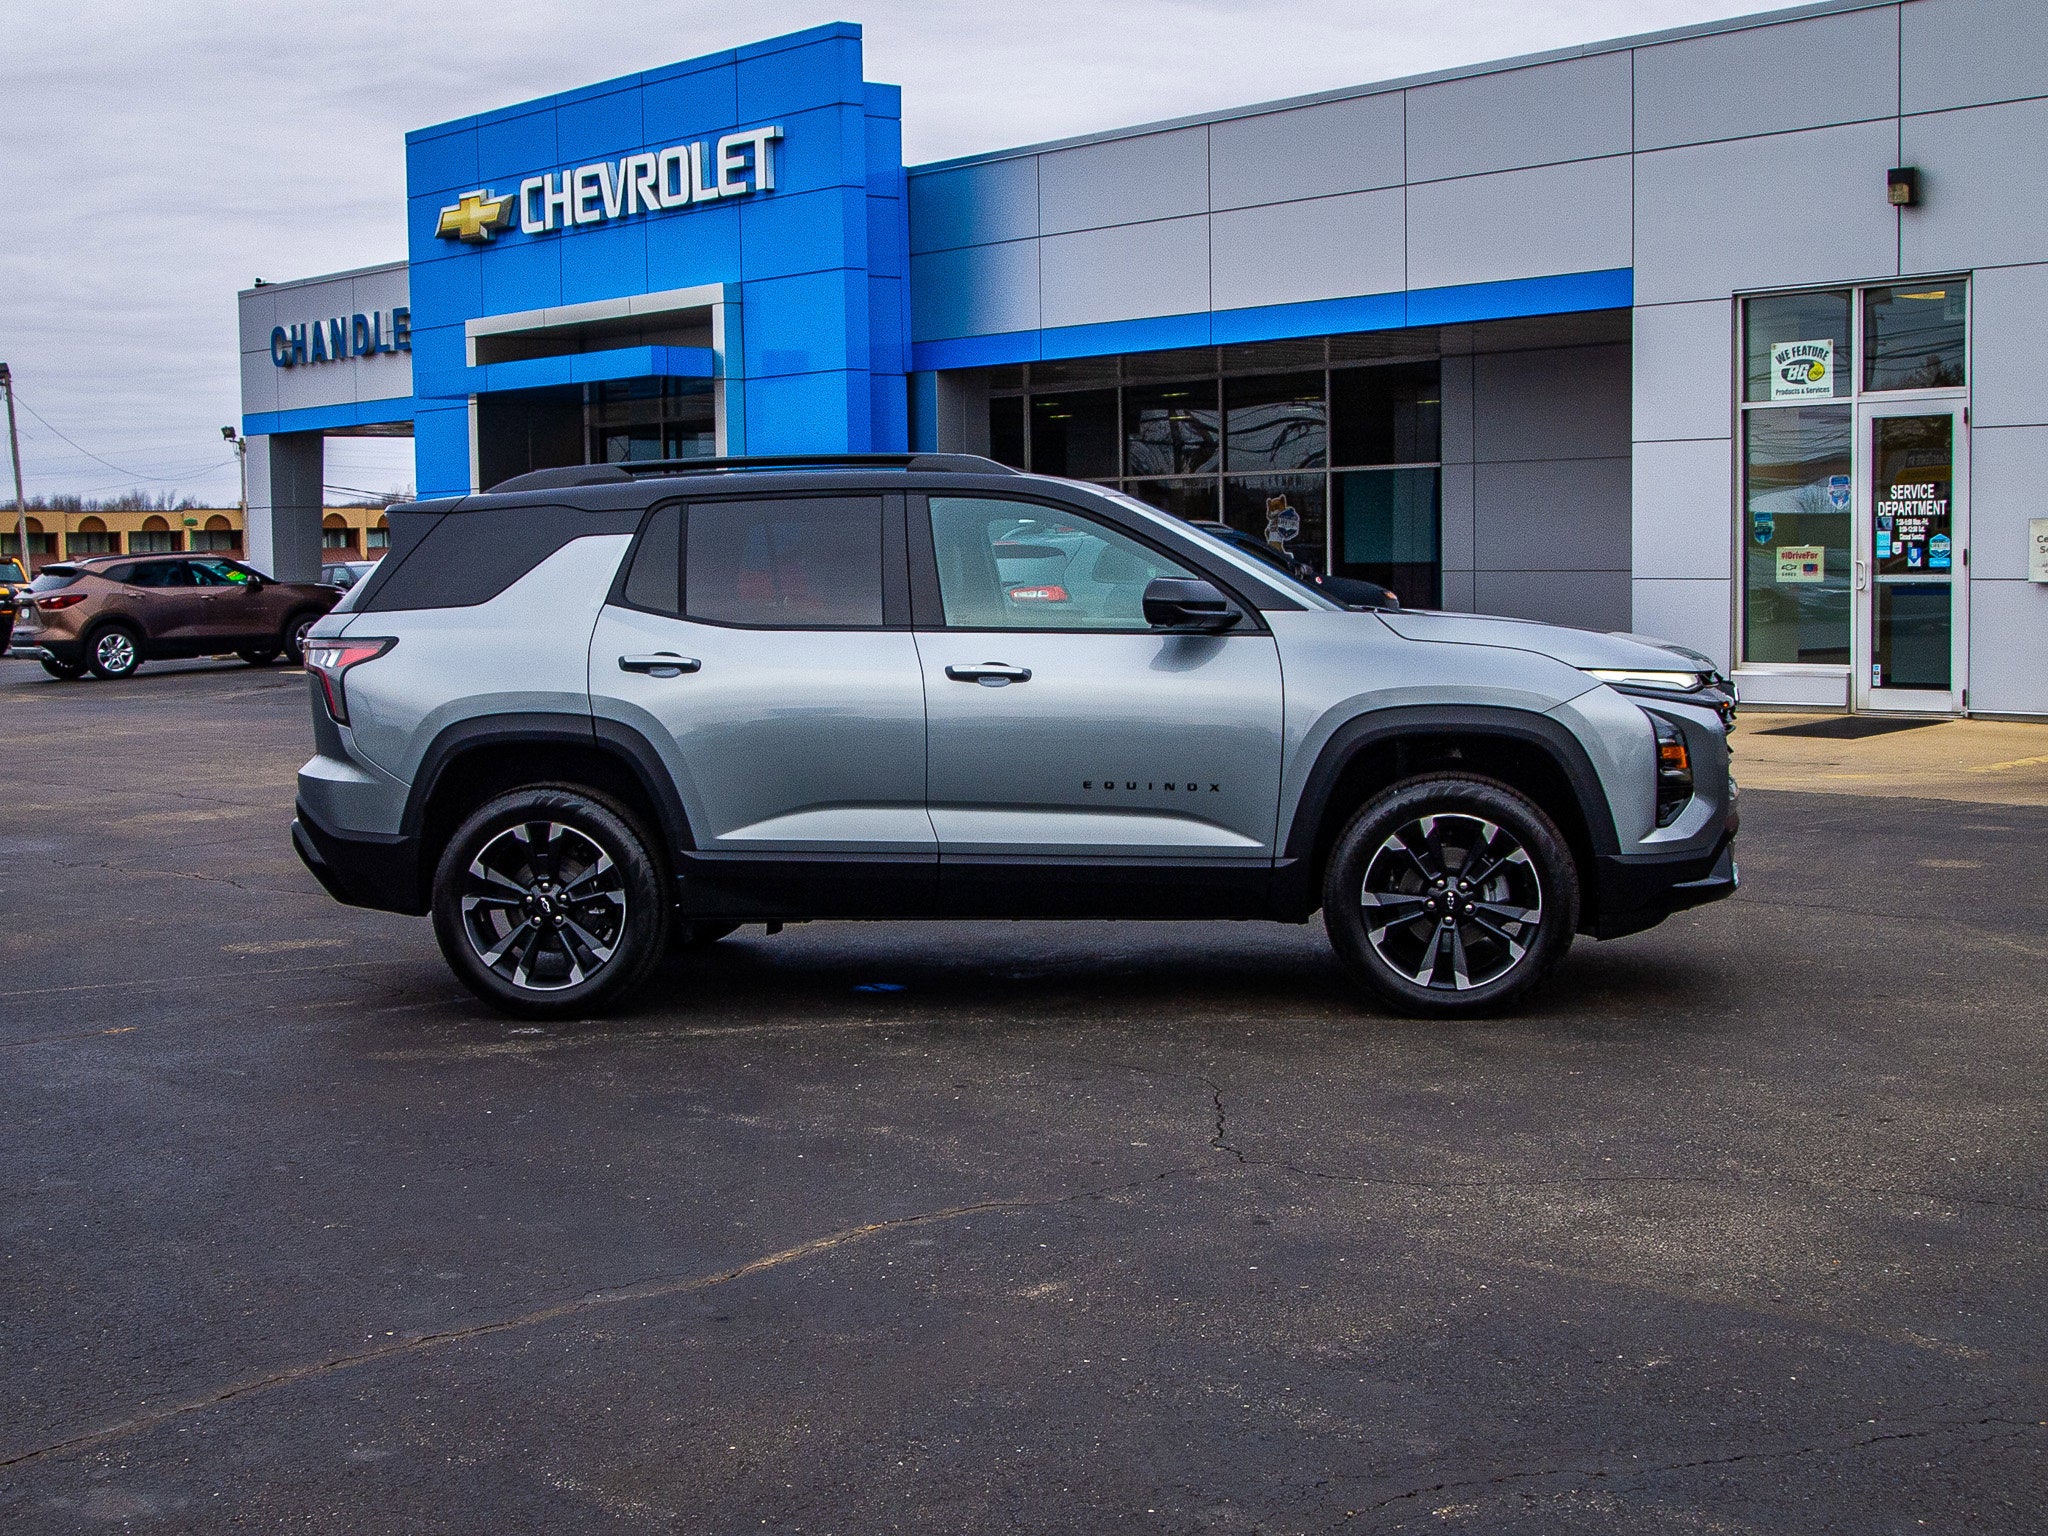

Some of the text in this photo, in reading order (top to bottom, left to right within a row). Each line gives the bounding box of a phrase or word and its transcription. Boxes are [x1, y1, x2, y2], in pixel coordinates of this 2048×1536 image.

[520, 126, 782, 235] CHEVROLET
[1775, 345, 1830, 365] WE FEATURE
[1786, 363, 1810, 380] BG
[1776, 388, 1800, 396] Products
[1806, 386, 1830, 394] Services
[1890, 484, 1935, 500] SERVICE
[1878, 500, 1947, 516] DEPARTMENT
[1083, 780, 1220, 792] EQUINOX
